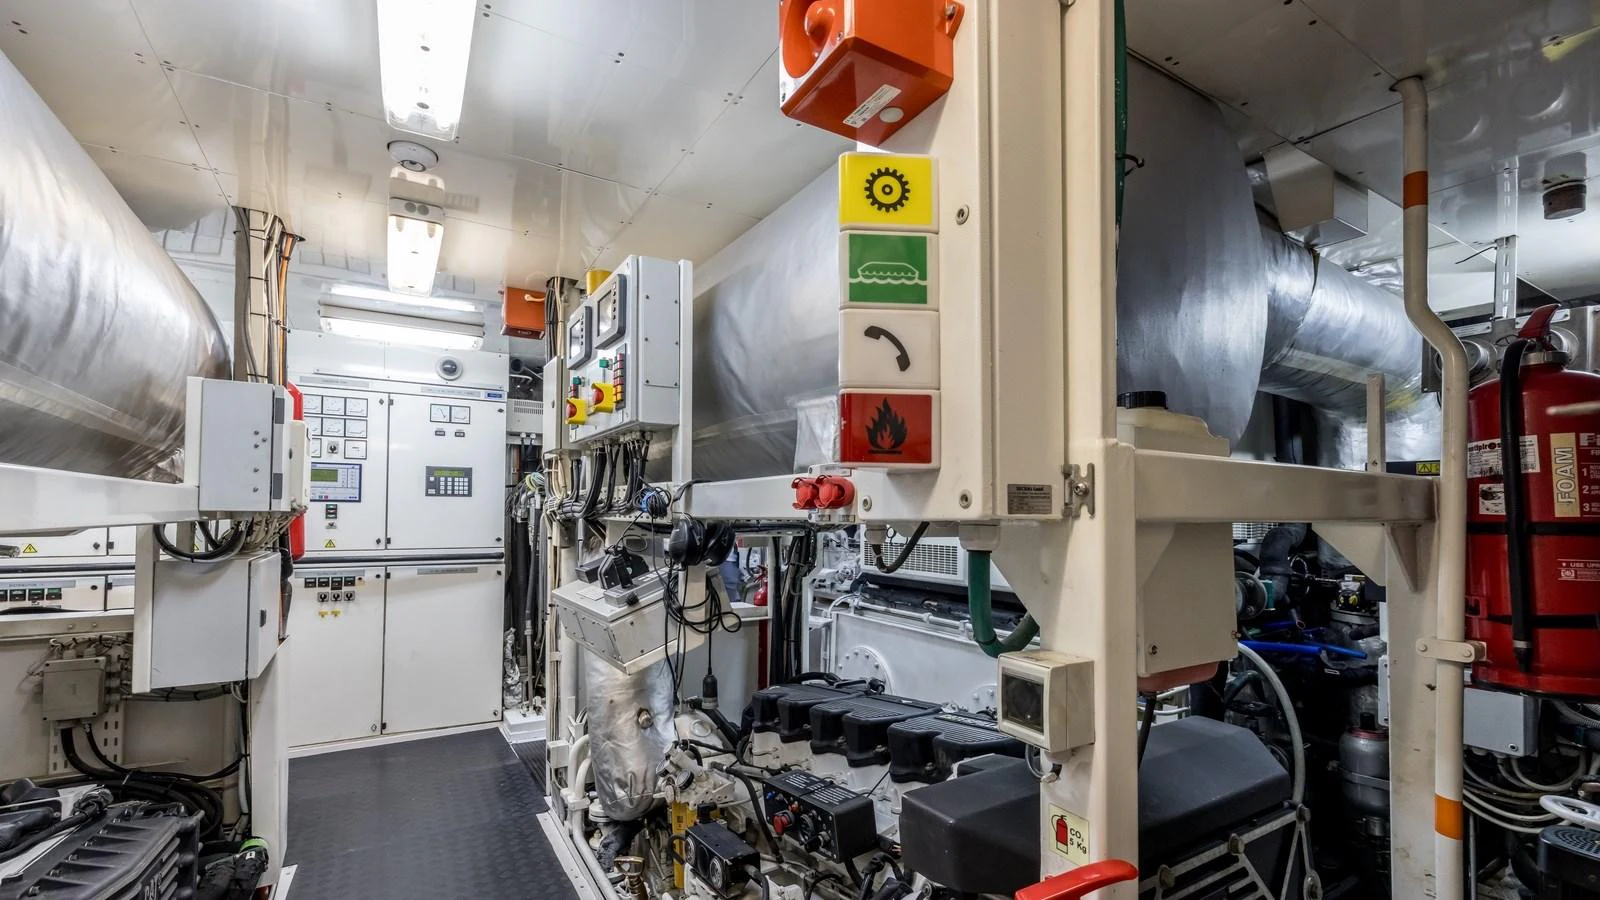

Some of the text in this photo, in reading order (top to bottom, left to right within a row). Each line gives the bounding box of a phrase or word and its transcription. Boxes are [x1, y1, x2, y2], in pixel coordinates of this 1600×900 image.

[1554, 447, 1576, 505] FOAM
[1581, 467, 1587, 477] 1
[1582, 485, 1589, 494] 2
[1583, 502, 1590, 512] 3
[1069, 838, 1087, 855] 5 Kg
